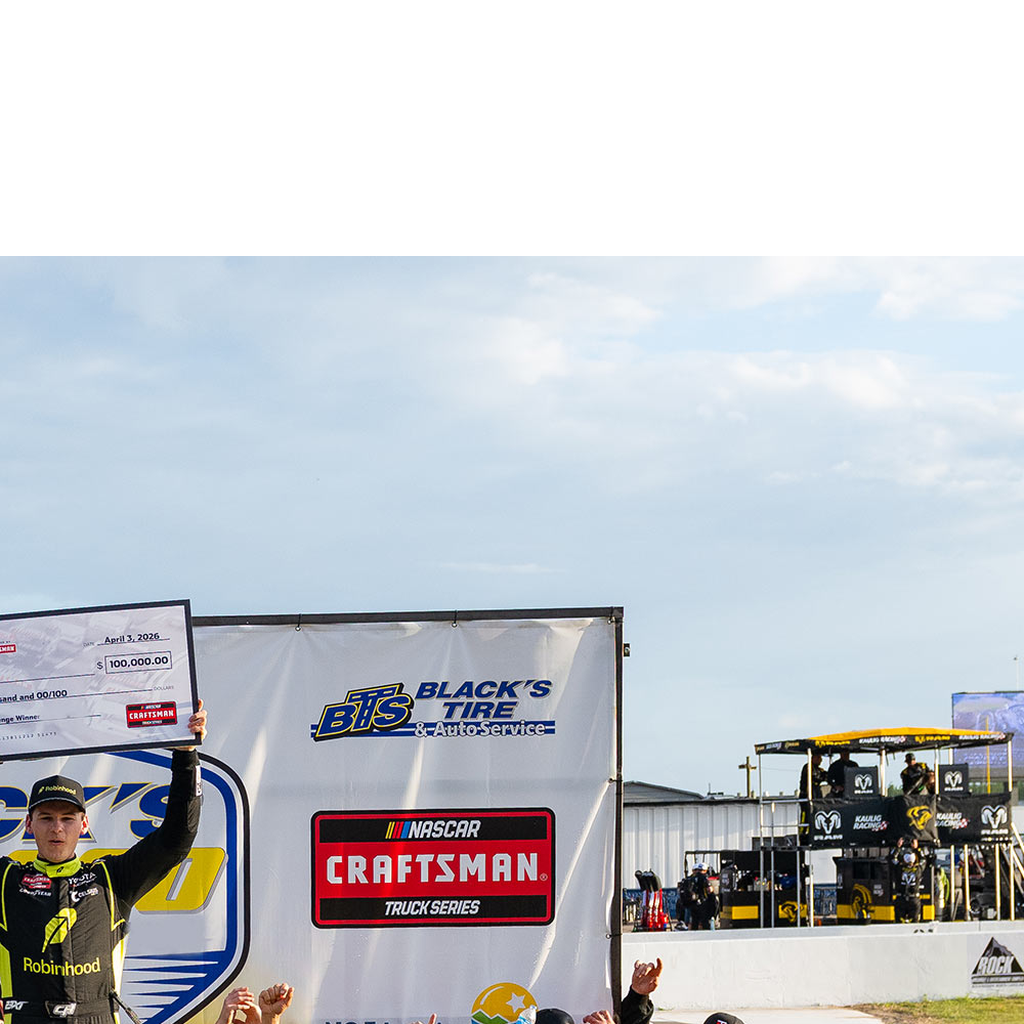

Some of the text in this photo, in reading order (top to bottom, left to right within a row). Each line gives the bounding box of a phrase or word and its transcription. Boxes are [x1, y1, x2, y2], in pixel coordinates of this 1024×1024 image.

[104, 636, 124, 645] April
[137, 633, 160, 641] 2026
[96, 656, 169, 670] $ 100,000.00
[19, 693, 34, 701] and
[36, 690, 68, 700] 00/100
[416, 680, 552, 699] BLACK'S
[129, 710, 174, 719] CRAFTSMAN
[314, 683, 414, 741] BTS
[442, 701, 519, 719] TIRE
[414, 722, 428, 737] &
[937, 813, 962, 821] KAULIG
[409, 820, 481, 839] NASCAR
[853, 822, 881, 830] RACING
[326, 853, 538, 884] CRAFTSMAN
[385, 900, 480, 915] TRUCK SERIES
[24, 957, 101, 977] Robinhood
[977, 956, 1014, 974] ROCK
